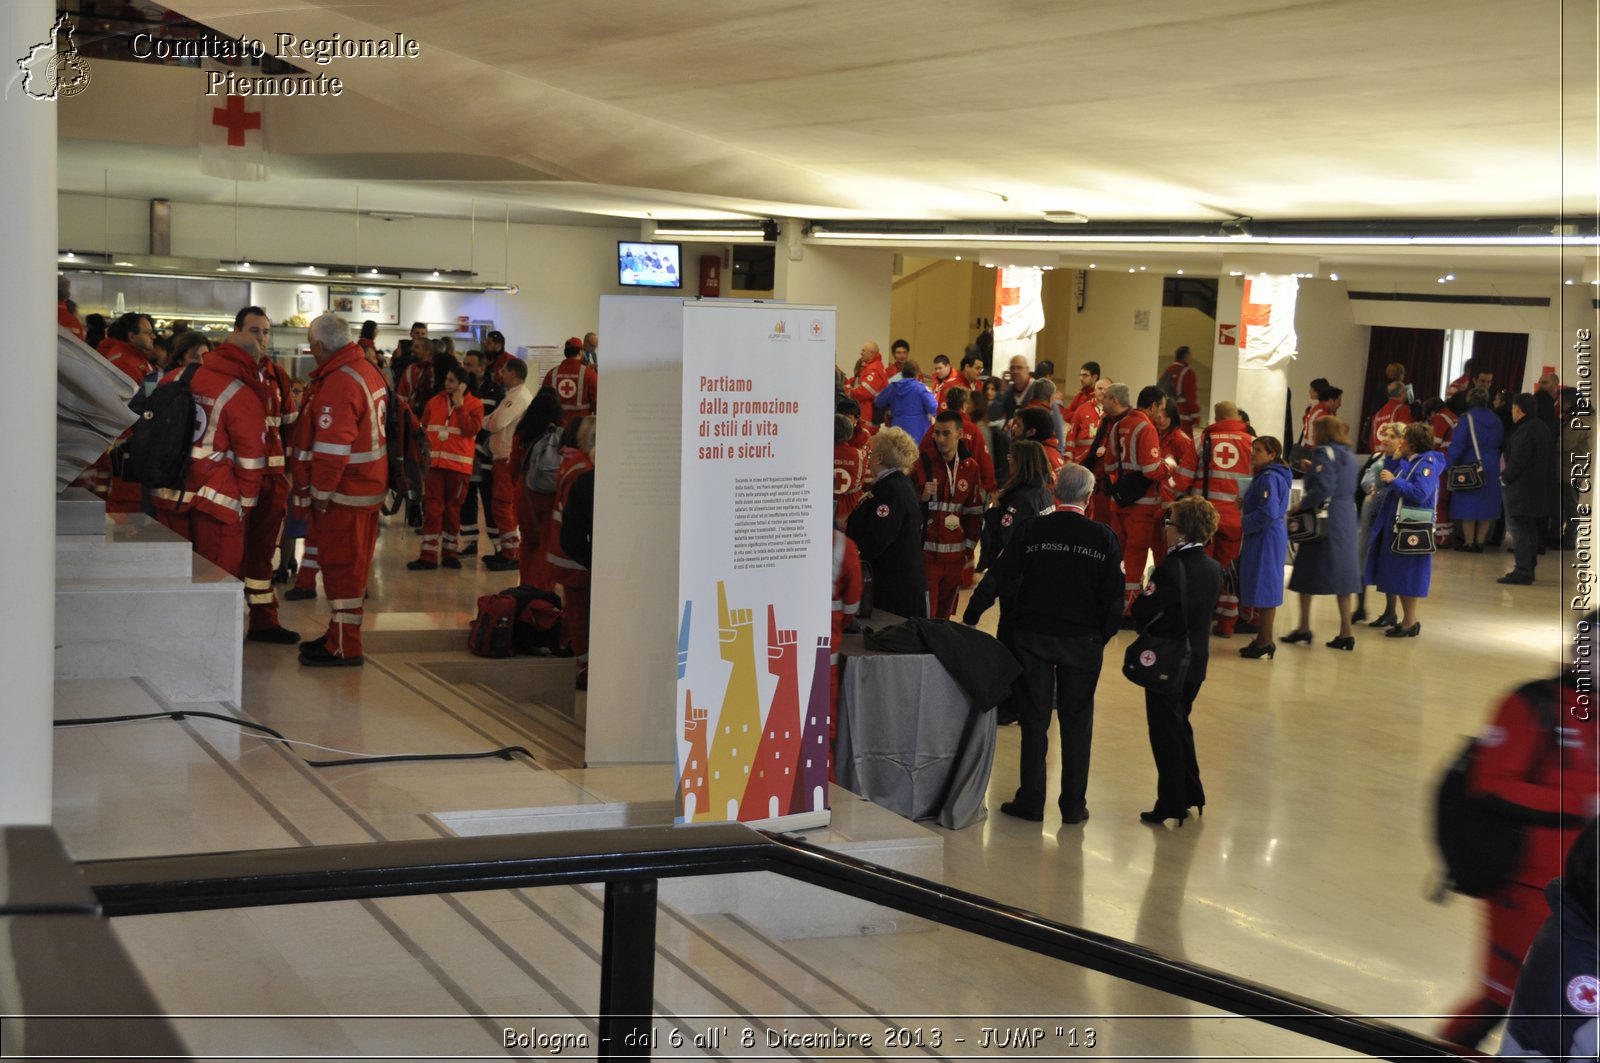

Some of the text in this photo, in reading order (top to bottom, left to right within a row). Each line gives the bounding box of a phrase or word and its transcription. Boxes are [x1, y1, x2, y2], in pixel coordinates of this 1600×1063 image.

[700, 376, 753, 392] Partiamo
[700, 398, 799, 418] dalla promozione
[699, 420, 778, 437] di stili di vita
[698, 442, 775, 460] sani e sicuri.
[1041, 543, 1070, 552] ROSSA
